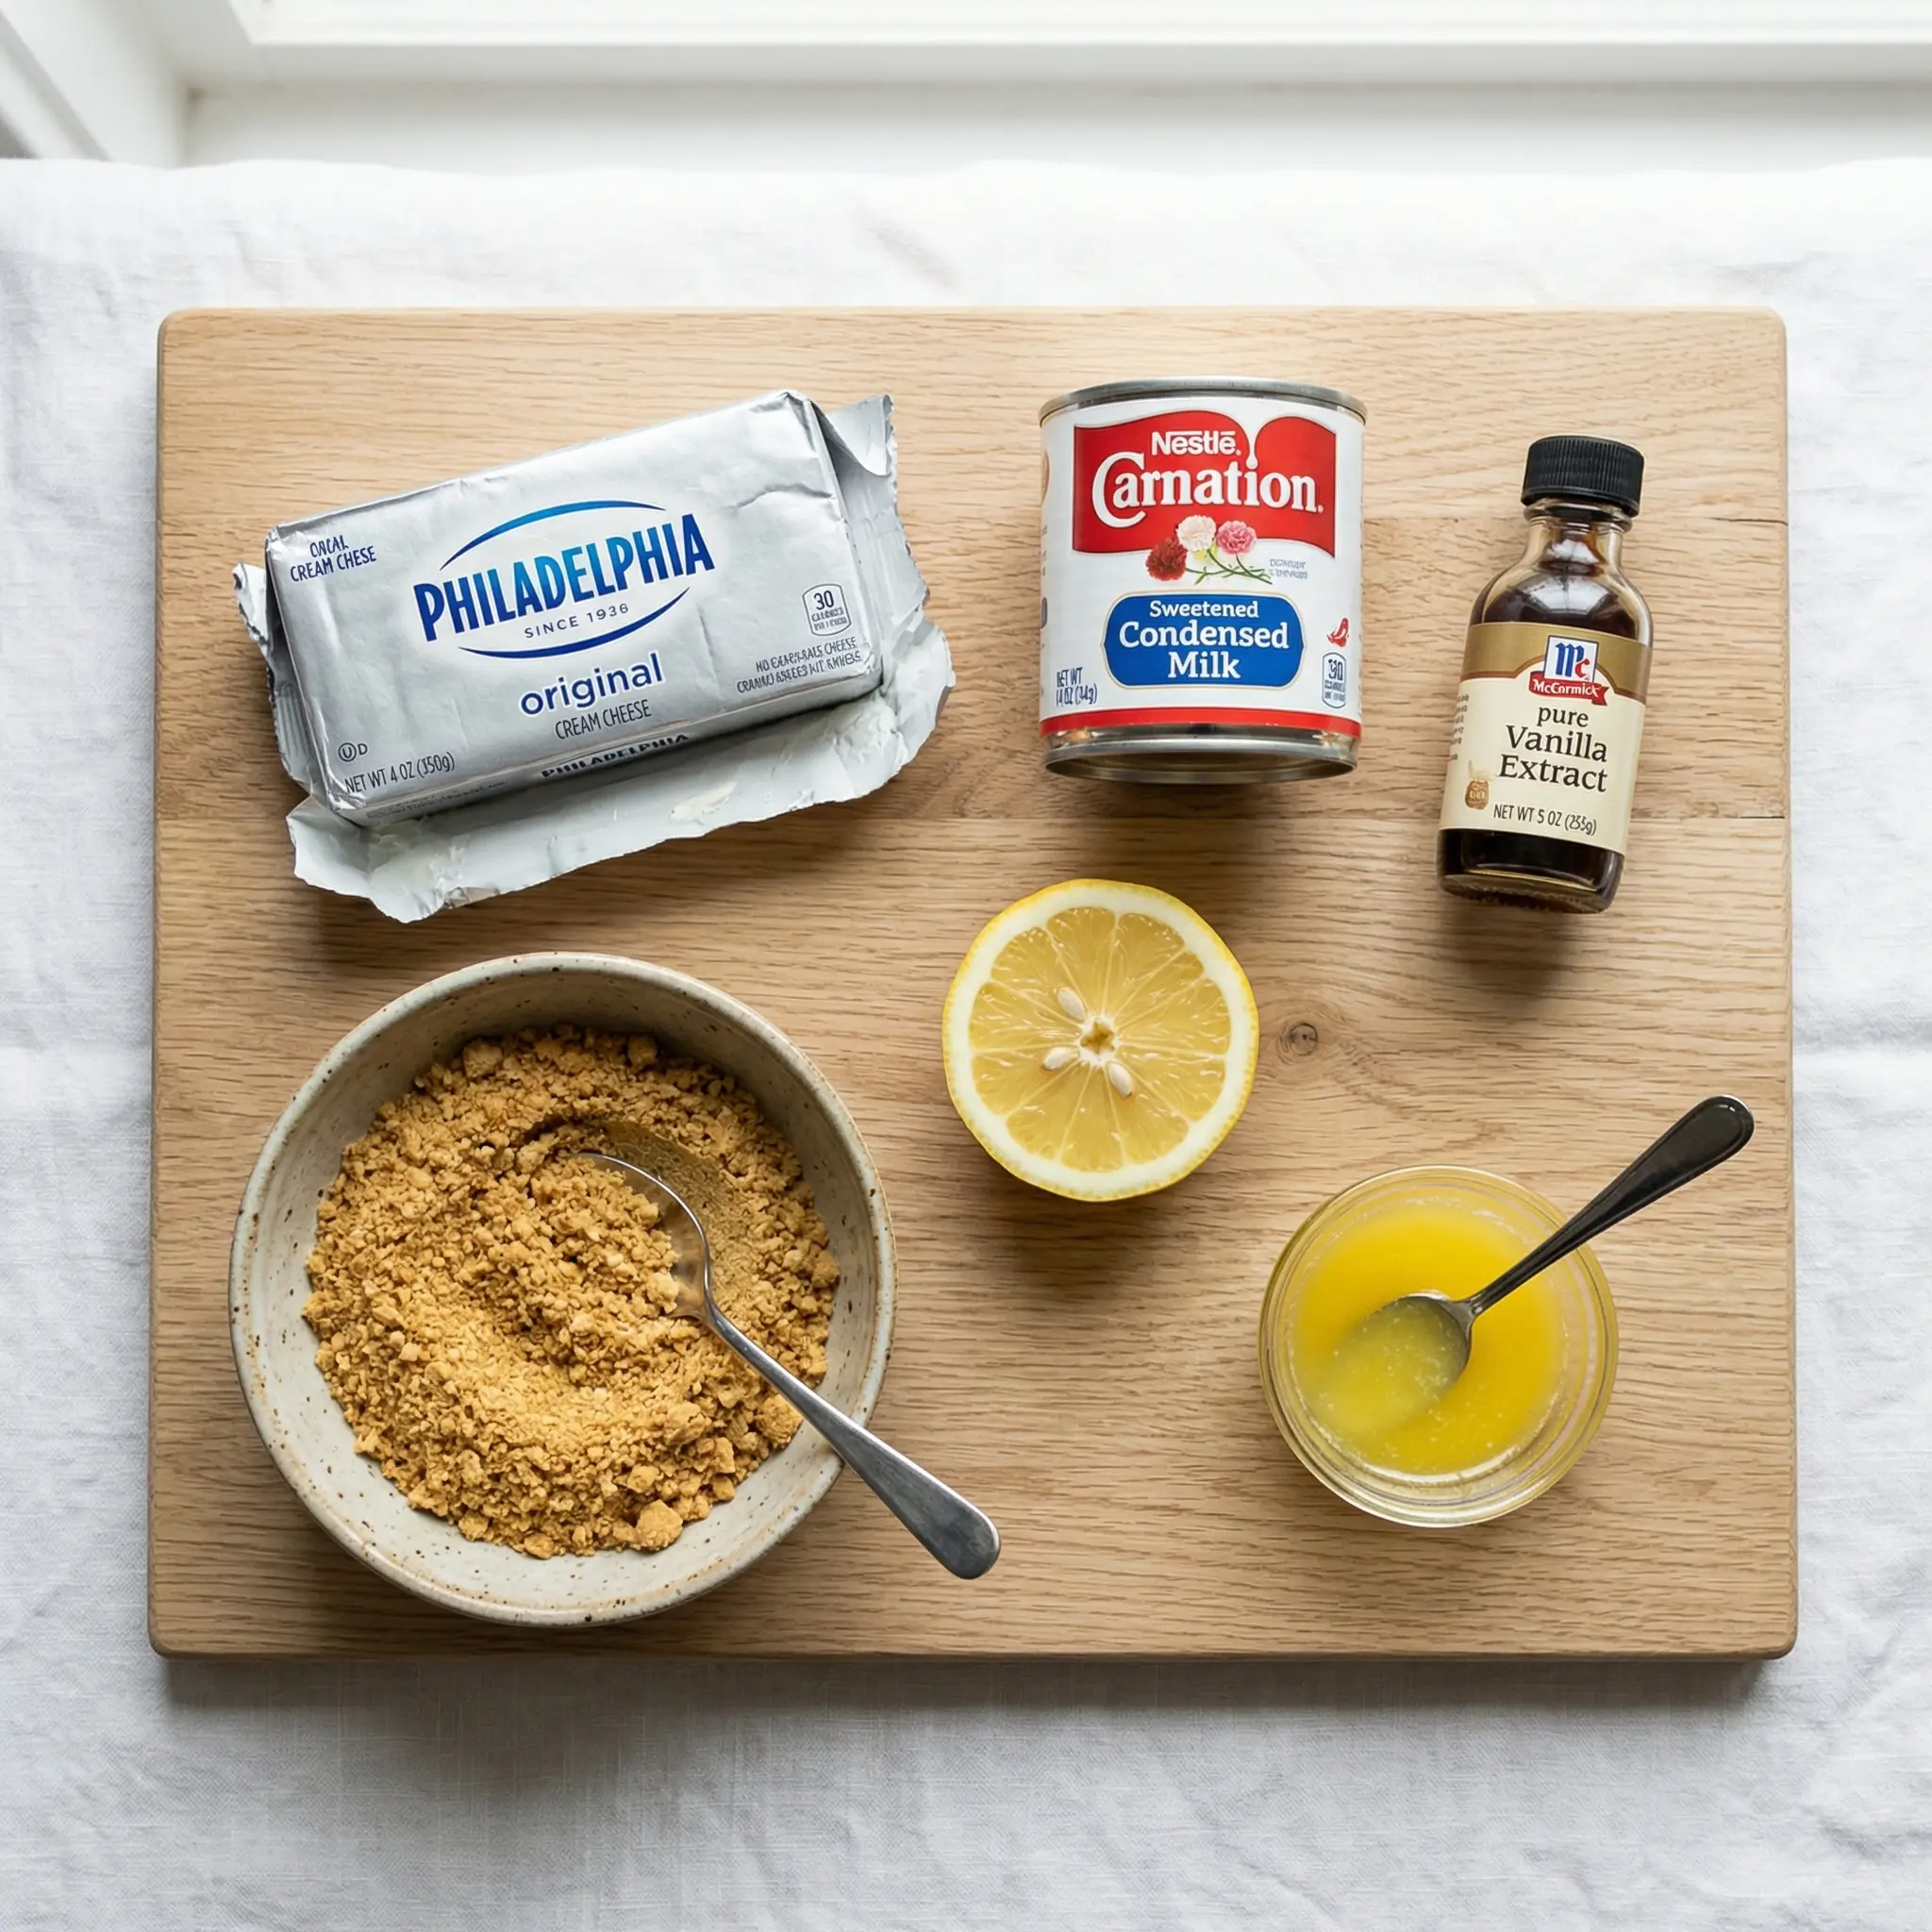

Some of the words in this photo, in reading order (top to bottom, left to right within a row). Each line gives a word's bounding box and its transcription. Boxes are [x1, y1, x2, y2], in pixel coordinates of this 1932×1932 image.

[290, 557, 334, 582] CREAM
[337, 545, 377, 571] CHESE
[413, 513, 716, 642] PHILADELPHIA
[813, 590, 835, 610] 30
[1149, 600, 1259, 619] Sweetened
[524, 616, 579, 639] SINCE
[586, 603, 629, 624] 1936
[1119, 620, 1289, 649] Condensed
[1168, 651, 1241, 679] Milk
[520, 653, 664, 715] original
[1532, 678, 1600, 698] McCormick
[555, 711, 602, 741] CREAM
[603, 700, 652, 727] CHEESE
[1536, 707, 1590, 727] pure
[541, 734, 690, 778] PHILADELPHIA
[1506, 724, 1607, 762] Vanilla
[344, 774, 367, 793] NET
[367, 768, 387, 789] WT
[390, 766, 398, 783] 4
[399, 761, 416, 781] OZ
[1498, 754, 1608, 792] Extract
[1493, 804, 1515, 820] NET
[1517, 806, 1536, 823] WT
[1537, 808, 1545, 824] 5
[1547, 810, 1563, 827] OZ
